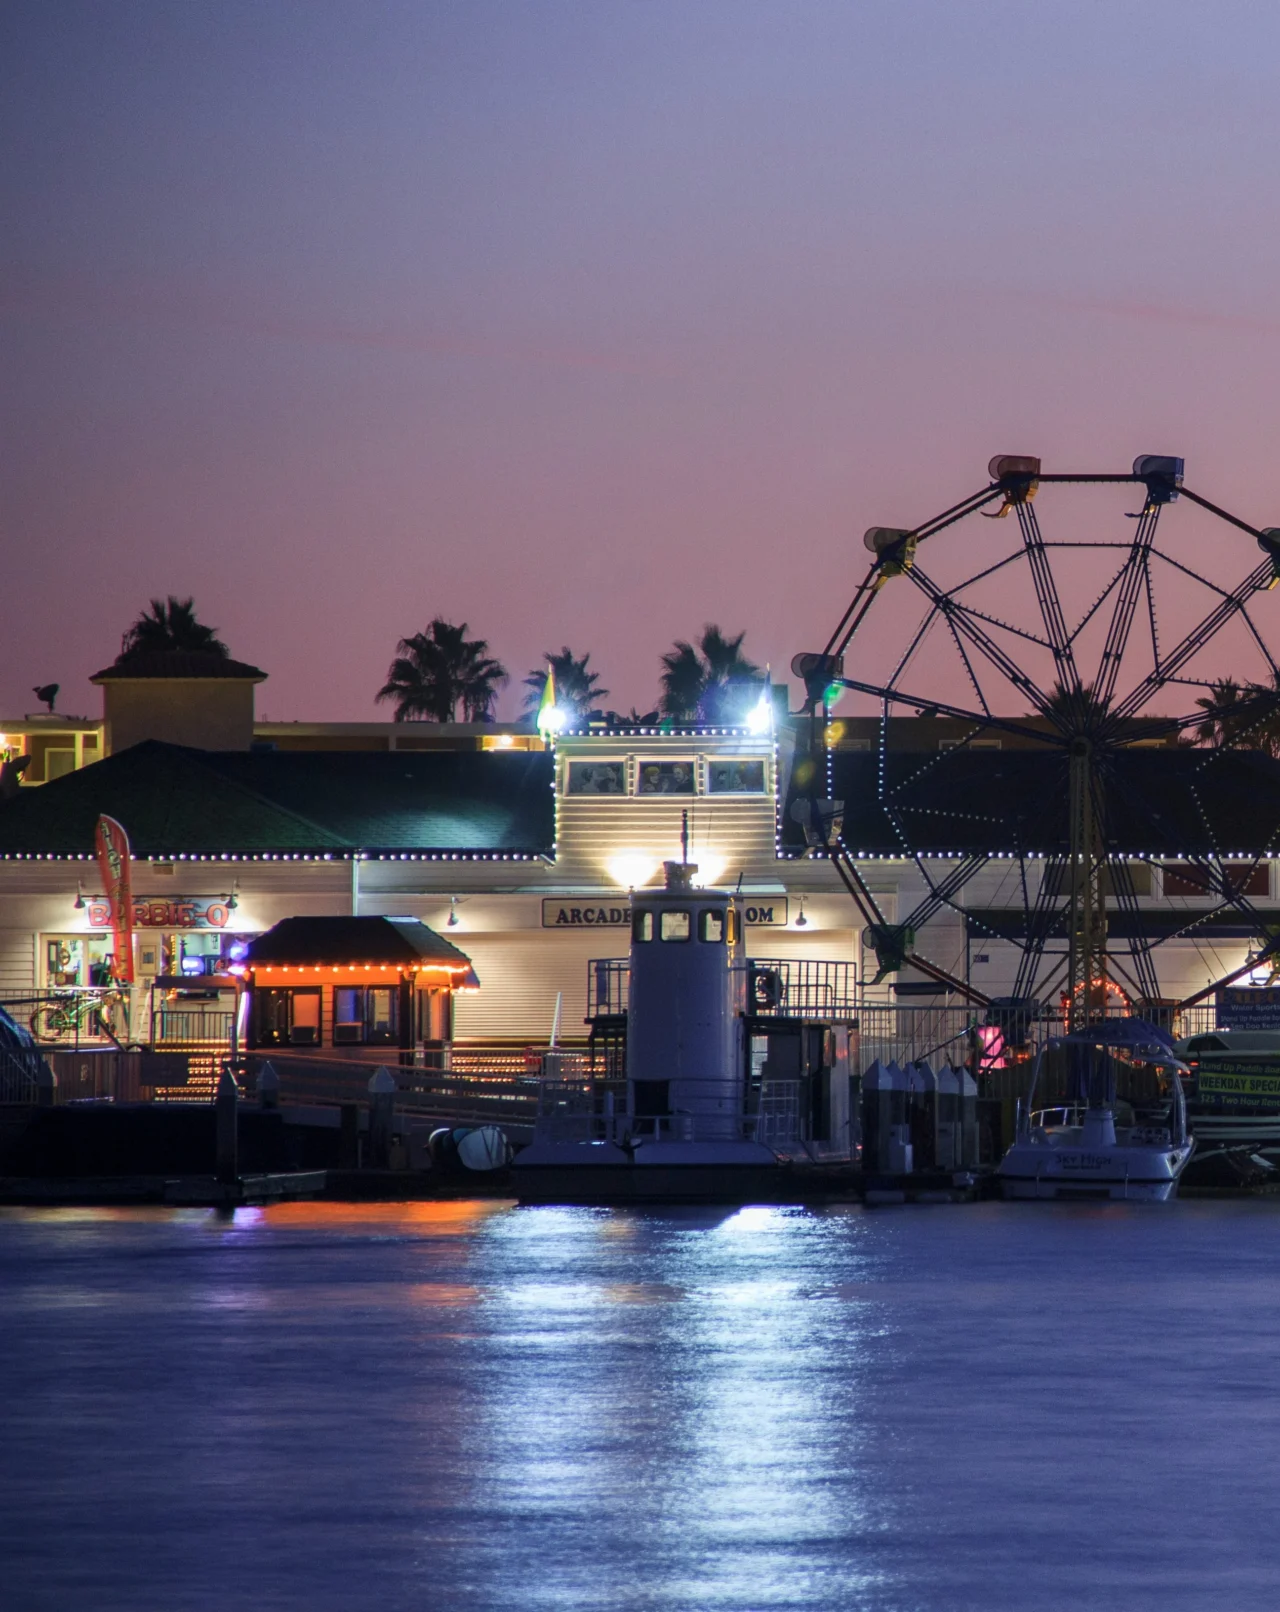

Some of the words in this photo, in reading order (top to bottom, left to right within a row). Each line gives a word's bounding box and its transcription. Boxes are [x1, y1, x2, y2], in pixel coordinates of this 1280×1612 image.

[88, 903, 230, 928] BRBIE-Q
[556, 907, 632, 924] ARCADE
[746, 907, 774, 922] OM
[1255, 1004, 1280, 1012] Sports
[1199, 1061, 1222, 1070] Stand
[1223, 1063, 1235, 1073] Up
[1236, 1063, 1264, 1073] Paddle
[1200, 1075, 1247, 1090] WEEKDAY
[1200, 1093, 1216, 1104] $25
[1221, 1095, 1239, 1105] Two
[1240, 1096, 1260, 1106] Hour
